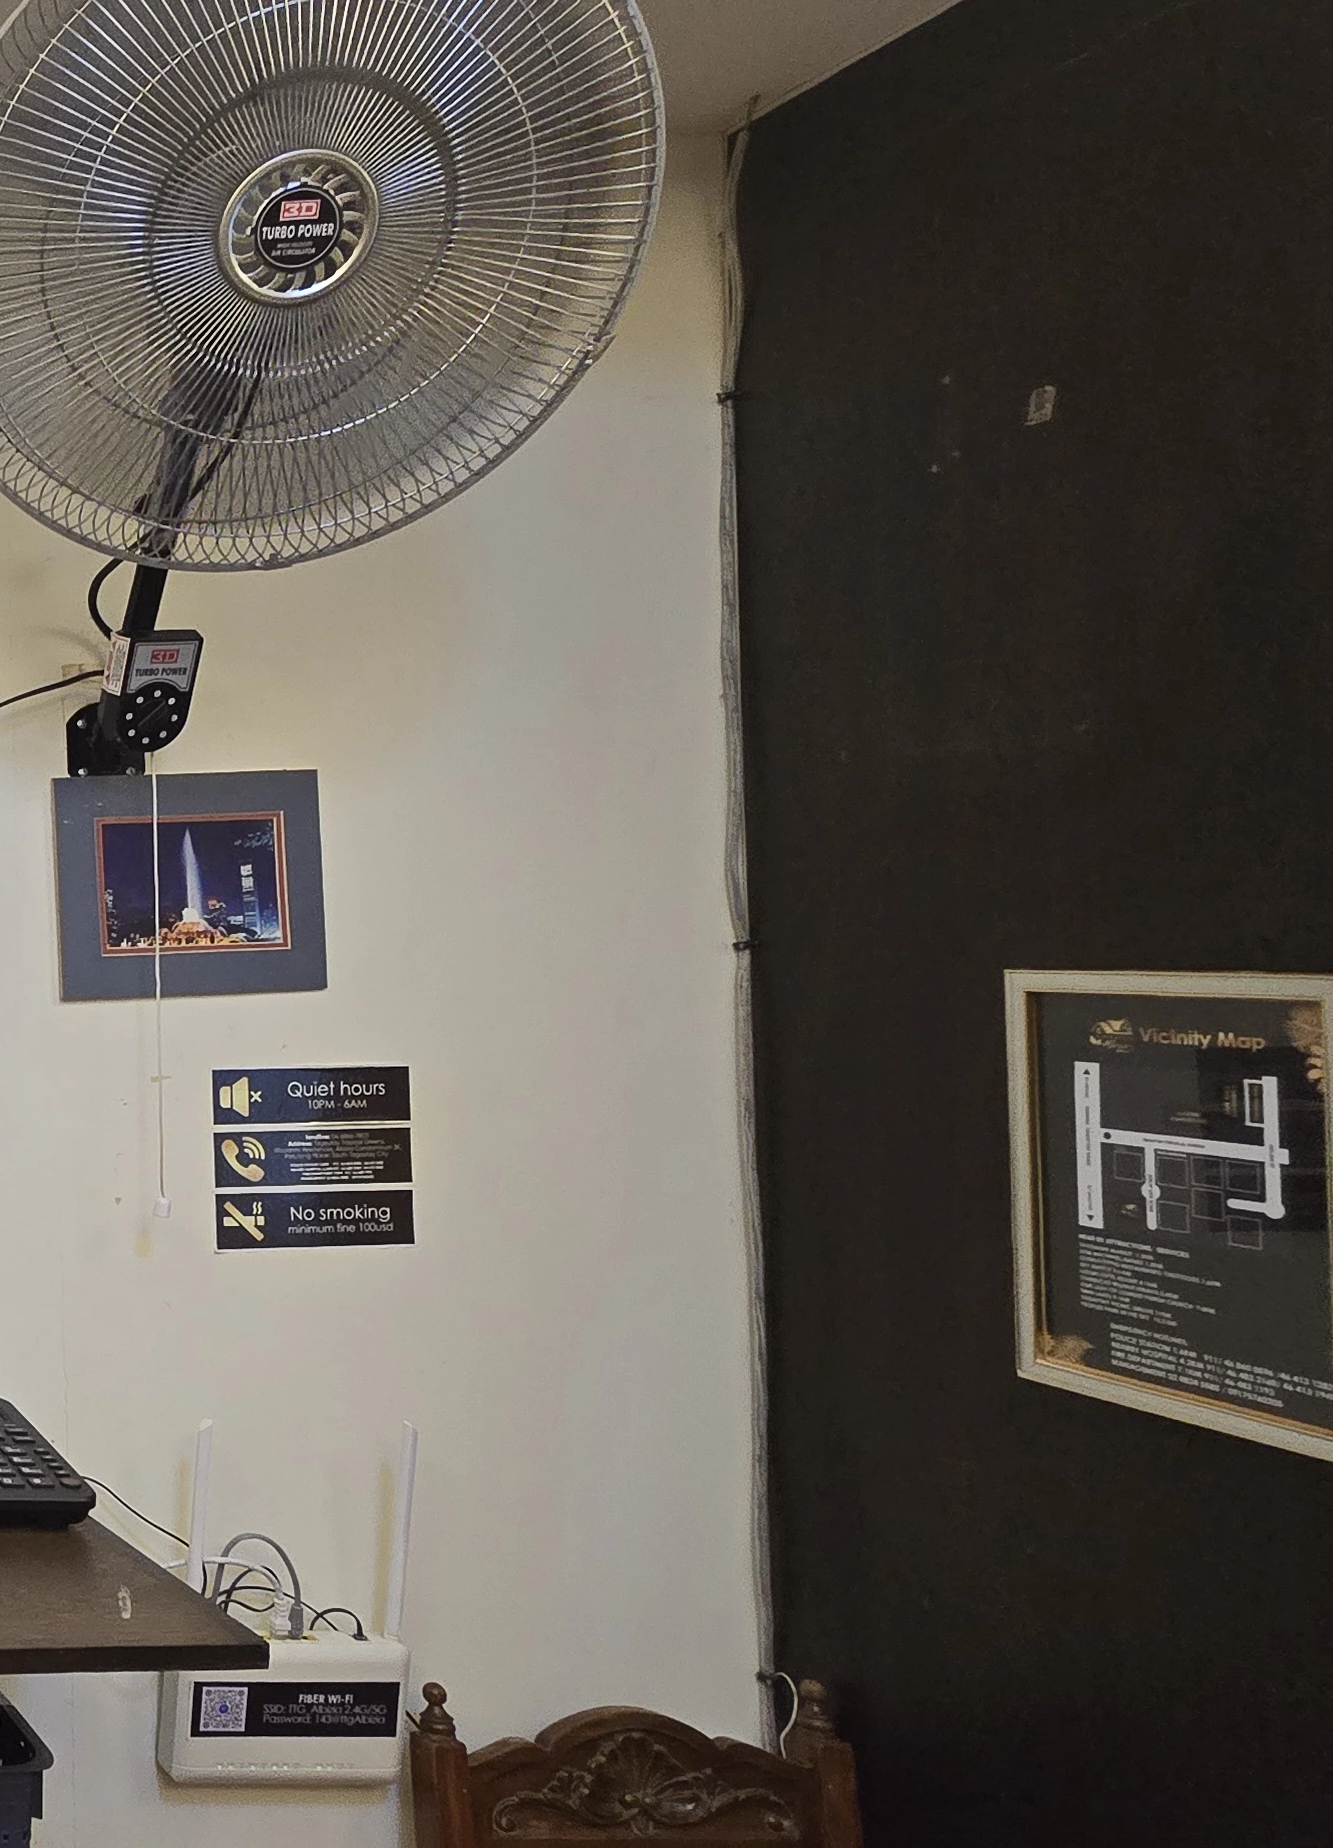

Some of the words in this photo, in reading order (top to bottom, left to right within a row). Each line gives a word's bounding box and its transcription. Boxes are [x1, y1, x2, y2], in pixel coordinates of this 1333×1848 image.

[284, 202, 318, 218] 3D
[262, 225, 295, 240] TURBO
[298, 223, 335, 238] POWER
[151, 651, 178, 663] 3D
[135, 668, 159, 677] TURBO
[160, 667, 188, 676] POWER
[1138, 1026, 1212, 1049] Vicinity
[1216, 1032, 1267, 1052] Map
[287, 1081, 335, 1098] Quiet
[340, 1080, 386, 1096] hours
[307, 1100, 335, 1109] 10PM
[343, 1099, 368, 1109] 6AM
[290, 1206, 315, 1221] No
[319, 1205, 391, 1222] smoking
[288, 1225, 334, 1234] minimum
[336, 1223, 356, 1233] fine
[359, 1222, 393, 1233] 100usd
[298, 1693, 325, 1703] FIBER
[262, 1704, 286, 1714] SSID:
[262, 1714, 312, 1724] Password:
